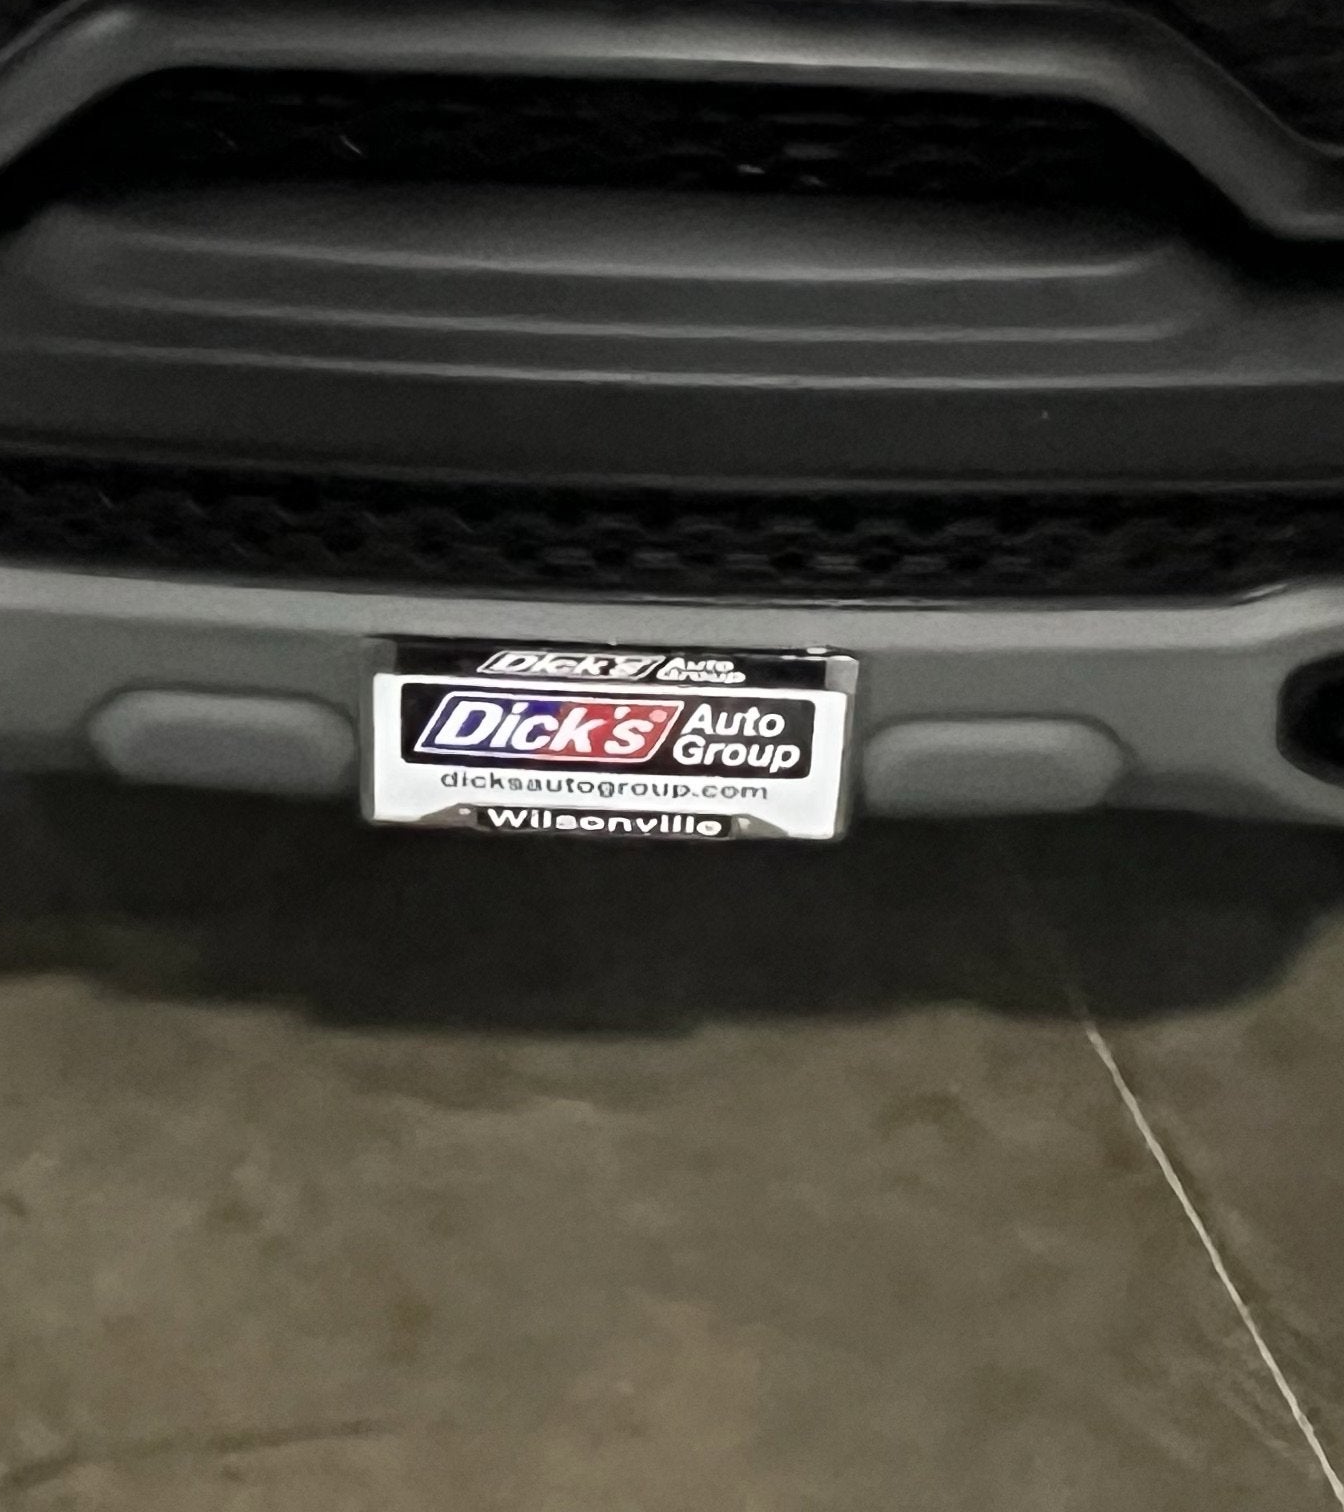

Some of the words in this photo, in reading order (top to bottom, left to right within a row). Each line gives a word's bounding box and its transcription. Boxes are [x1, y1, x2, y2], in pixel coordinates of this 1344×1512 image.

[435, 700, 656, 755] Dick's
[682, 703, 785, 738] Auto
[673, 738, 801, 773] Group
[440, 772, 769, 800] dicksautogroup.com
[487, 807, 723, 836] Wilsonville
